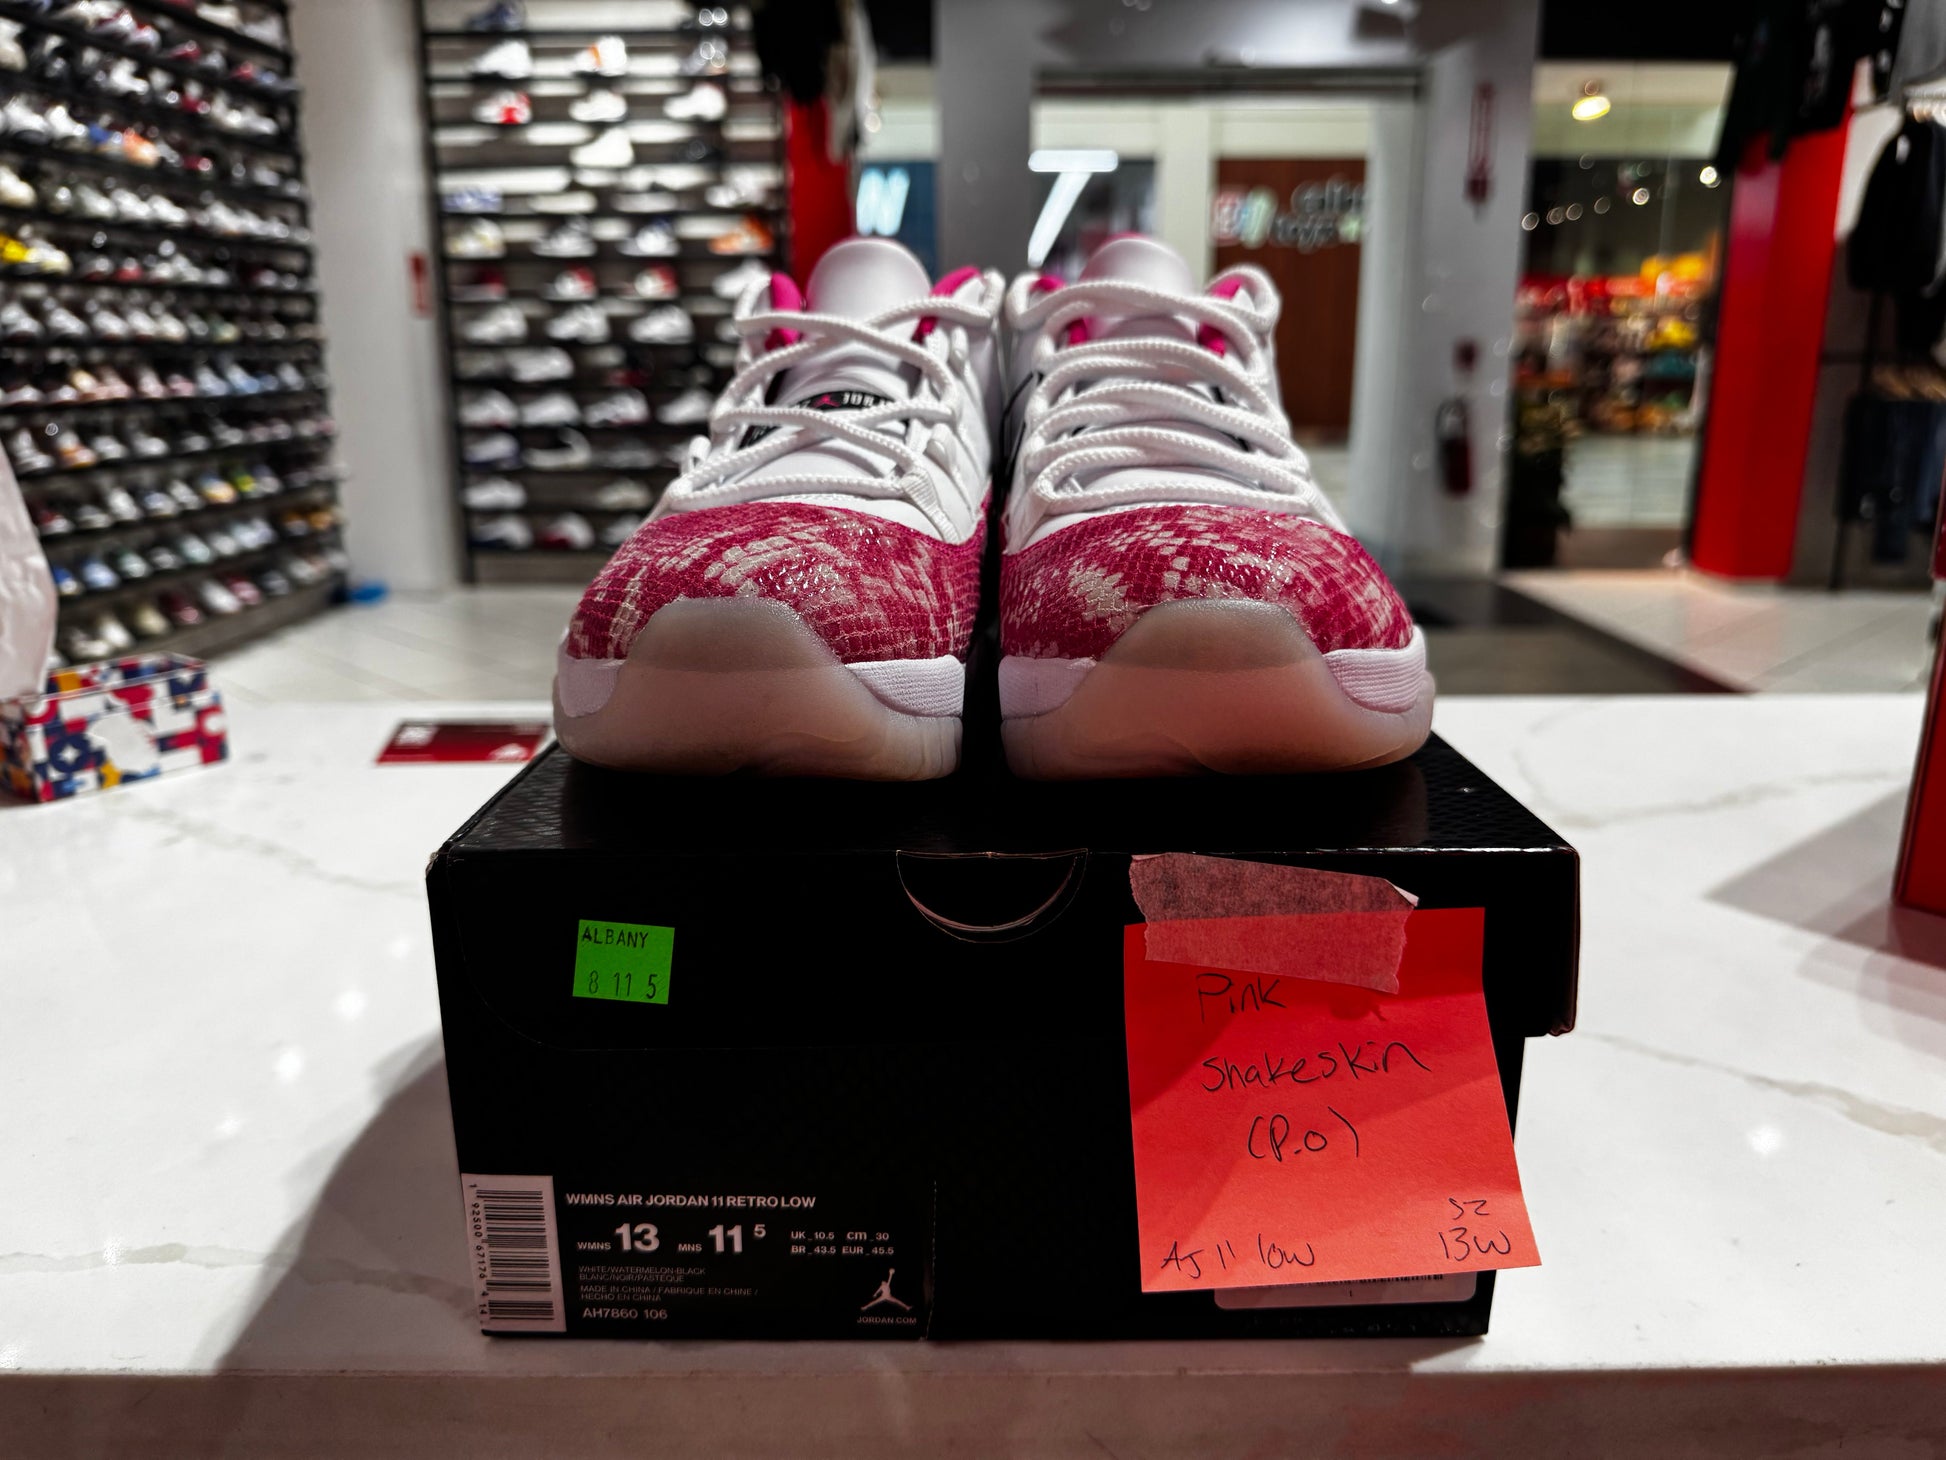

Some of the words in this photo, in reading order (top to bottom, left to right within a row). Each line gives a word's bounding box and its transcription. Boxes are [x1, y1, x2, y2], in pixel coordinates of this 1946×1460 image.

[582, 926, 649, 949] ALBANY
[588, 969, 599, 995] 8
[613, 971, 632, 997] 11
[645, 973, 658, 1000] 5
[1196, 972, 1287, 1024] Pink
[566, 1193, 615, 1205] WMNS
[617, 1194, 643, 1206] AIR
[645, 1194, 709, 1207] JORDAN
[711, 1195, 724, 1207] 11
[727, 1195, 779, 1208] RETRO
[781, 1196, 816, 1209] LOW
[471, 1202, 483, 1238] 92500
[577, 1241, 612, 1251] WMNS
[615, 1222, 660, 1252] 13
[678, 1243, 703, 1252] MNS
[708, 1224, 743, 1253] 11
[790, 1231, 806, 1239] UK
[814, 1231, 835, 1240] 10.5
[875, 1232, 890, 1241] 30
[790, 1245, 806, 1254] BR
[813, 1245, 837, 1254] 43.5
[841, 1246, 864, 1254] EUR
[871, 1246, 894, 1255] 45.5
[475, 1245, 487, 1279] 67176
[580, 1285, 607, 1293] MADE
[621, 1286, 651, 1294] CHINA
[658, 1287, 705, 1295] FABRIQUE
[723, 1288, 753, 1296] CHINE
[632, 1294, 662, 1302] CHINA
[582, 1307, 639, 1319] AH7860
[643, 1308, 669, 1320] 106
